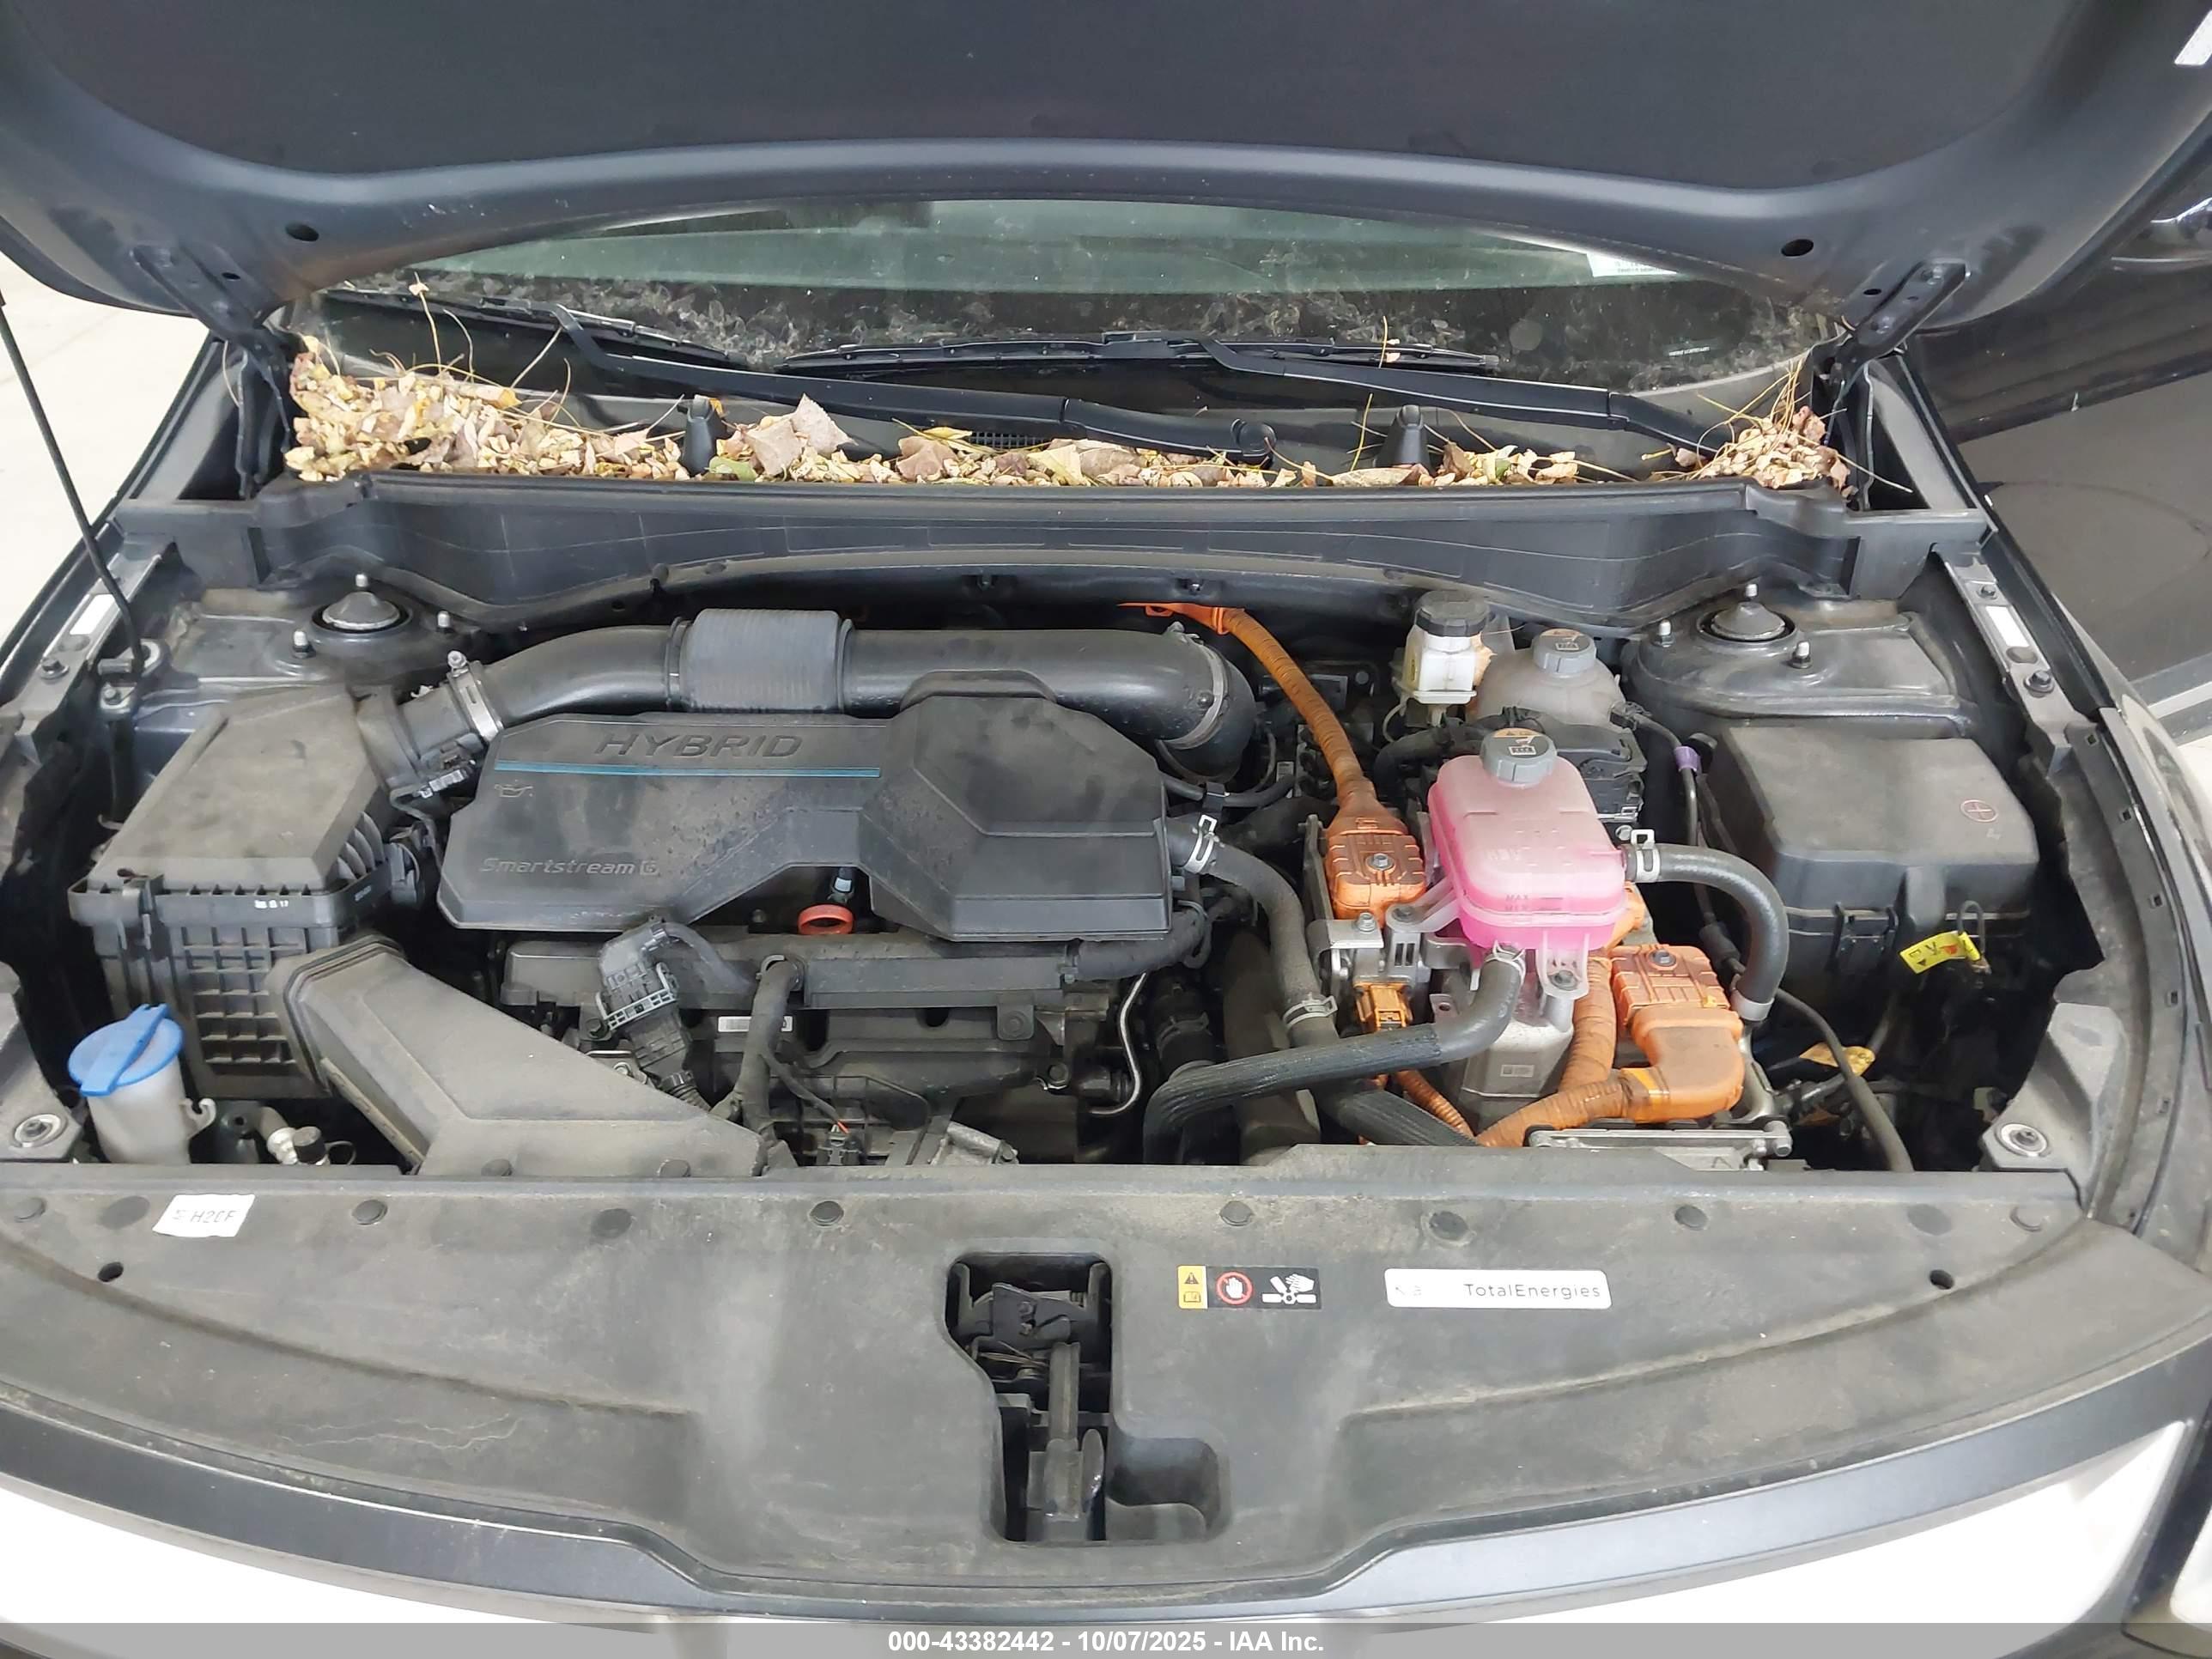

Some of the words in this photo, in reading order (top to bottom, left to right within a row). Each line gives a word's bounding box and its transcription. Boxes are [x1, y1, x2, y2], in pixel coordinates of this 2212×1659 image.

[594, 734, 803, 757] HYBRID
[480, 858, 635, 874] Smartstream
[1463, 1284, 1601, 1300] TotalEnergies
